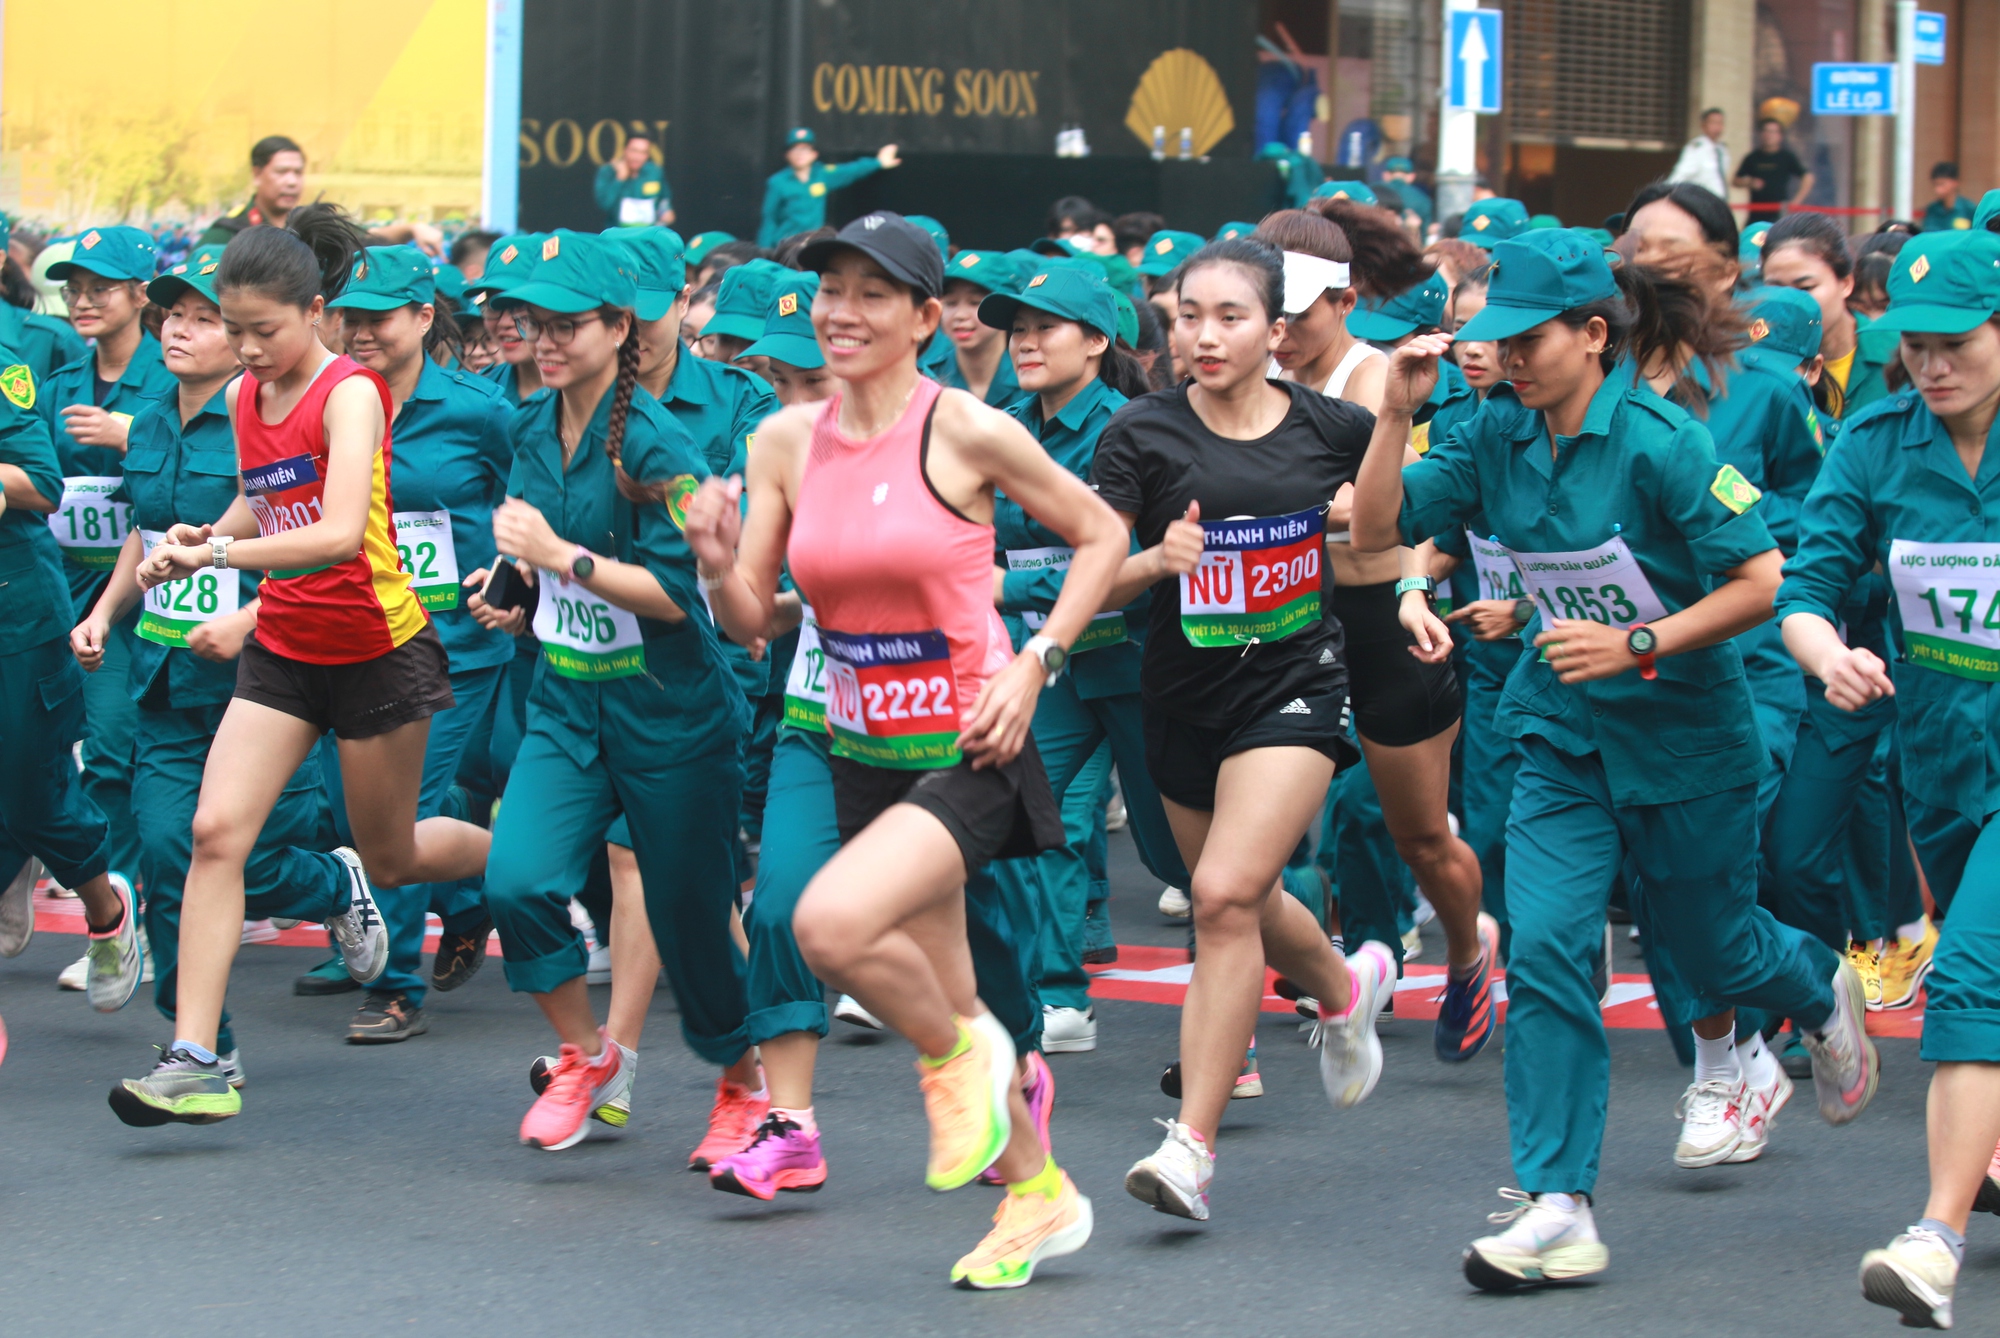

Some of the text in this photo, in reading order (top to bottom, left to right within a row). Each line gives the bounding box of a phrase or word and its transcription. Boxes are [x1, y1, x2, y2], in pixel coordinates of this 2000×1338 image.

[813, 62, 1040, 118] COMING SOON
[267, 466, 297, 487] NIÊN
[274, 496, 323, 534] 2301
[393, 519, 411, 529] ÂN
[1203, 519, 1308, 545] THANH NIÊN
[1044, 553, 1066, 566] DÂN
[1527, 561, 1560, 574] LƯỢNG
[1562, 559, 1582, 571] DÂN
[1584, 552, 1619, 570] QUÂN
[1900, 555, 1926, 569] LỰC
[1931, 554, 1978, 569] LƯỢNG
[1188, 548, 1319, 605] NỮ 2300
[153, 574, 218, 614] 1328
[1537, 583, 1638, 626] 1853
[552, 593, 617, 645] 1296
[1113, 626, 1122, 635] 47
[1189, 623, 1209, 637] VIỆT
[1227, 622, 1277, 636] 30/4/2023
[1281, 611, 1295, 627] LẦN
[1309, 602, 1320, 612] 47
[876, 638, 923, 660] NIÊN
[1912, 643, 1930, 661] VIỆT
[1947, 653, 1999, 672] 30/4/2023
[862, 676, 954, 721] 2222
